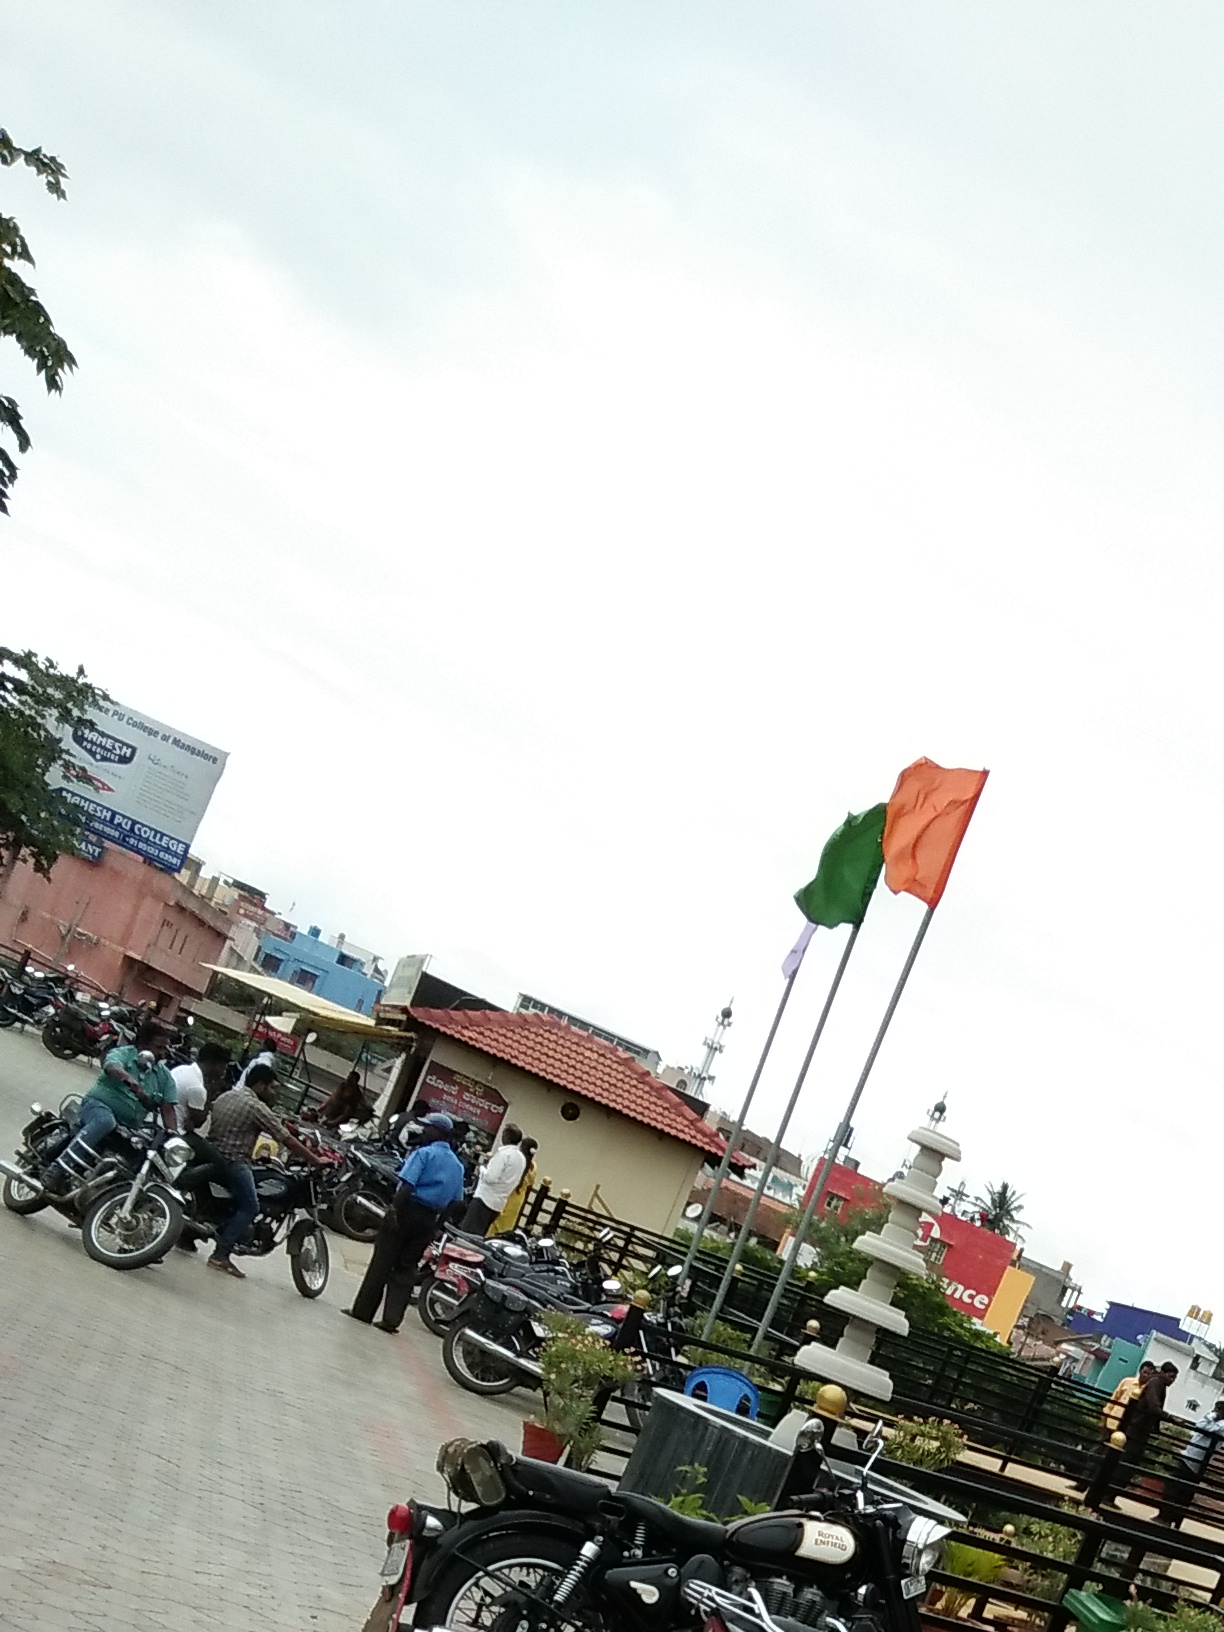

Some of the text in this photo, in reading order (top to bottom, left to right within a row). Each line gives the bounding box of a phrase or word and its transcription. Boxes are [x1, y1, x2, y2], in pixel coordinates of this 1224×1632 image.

[111, 707, 125, 722] PU
[125, 716, 160, 739] College
[172, 736, 218, 766] Mangalore
[113, 814, 132, 831] PU
[134, 821, 186, 856] COLLEGE
[814, 1538, 848, 1552] ENFIELD
[817, 1530, 844, 1542] ROYAL
